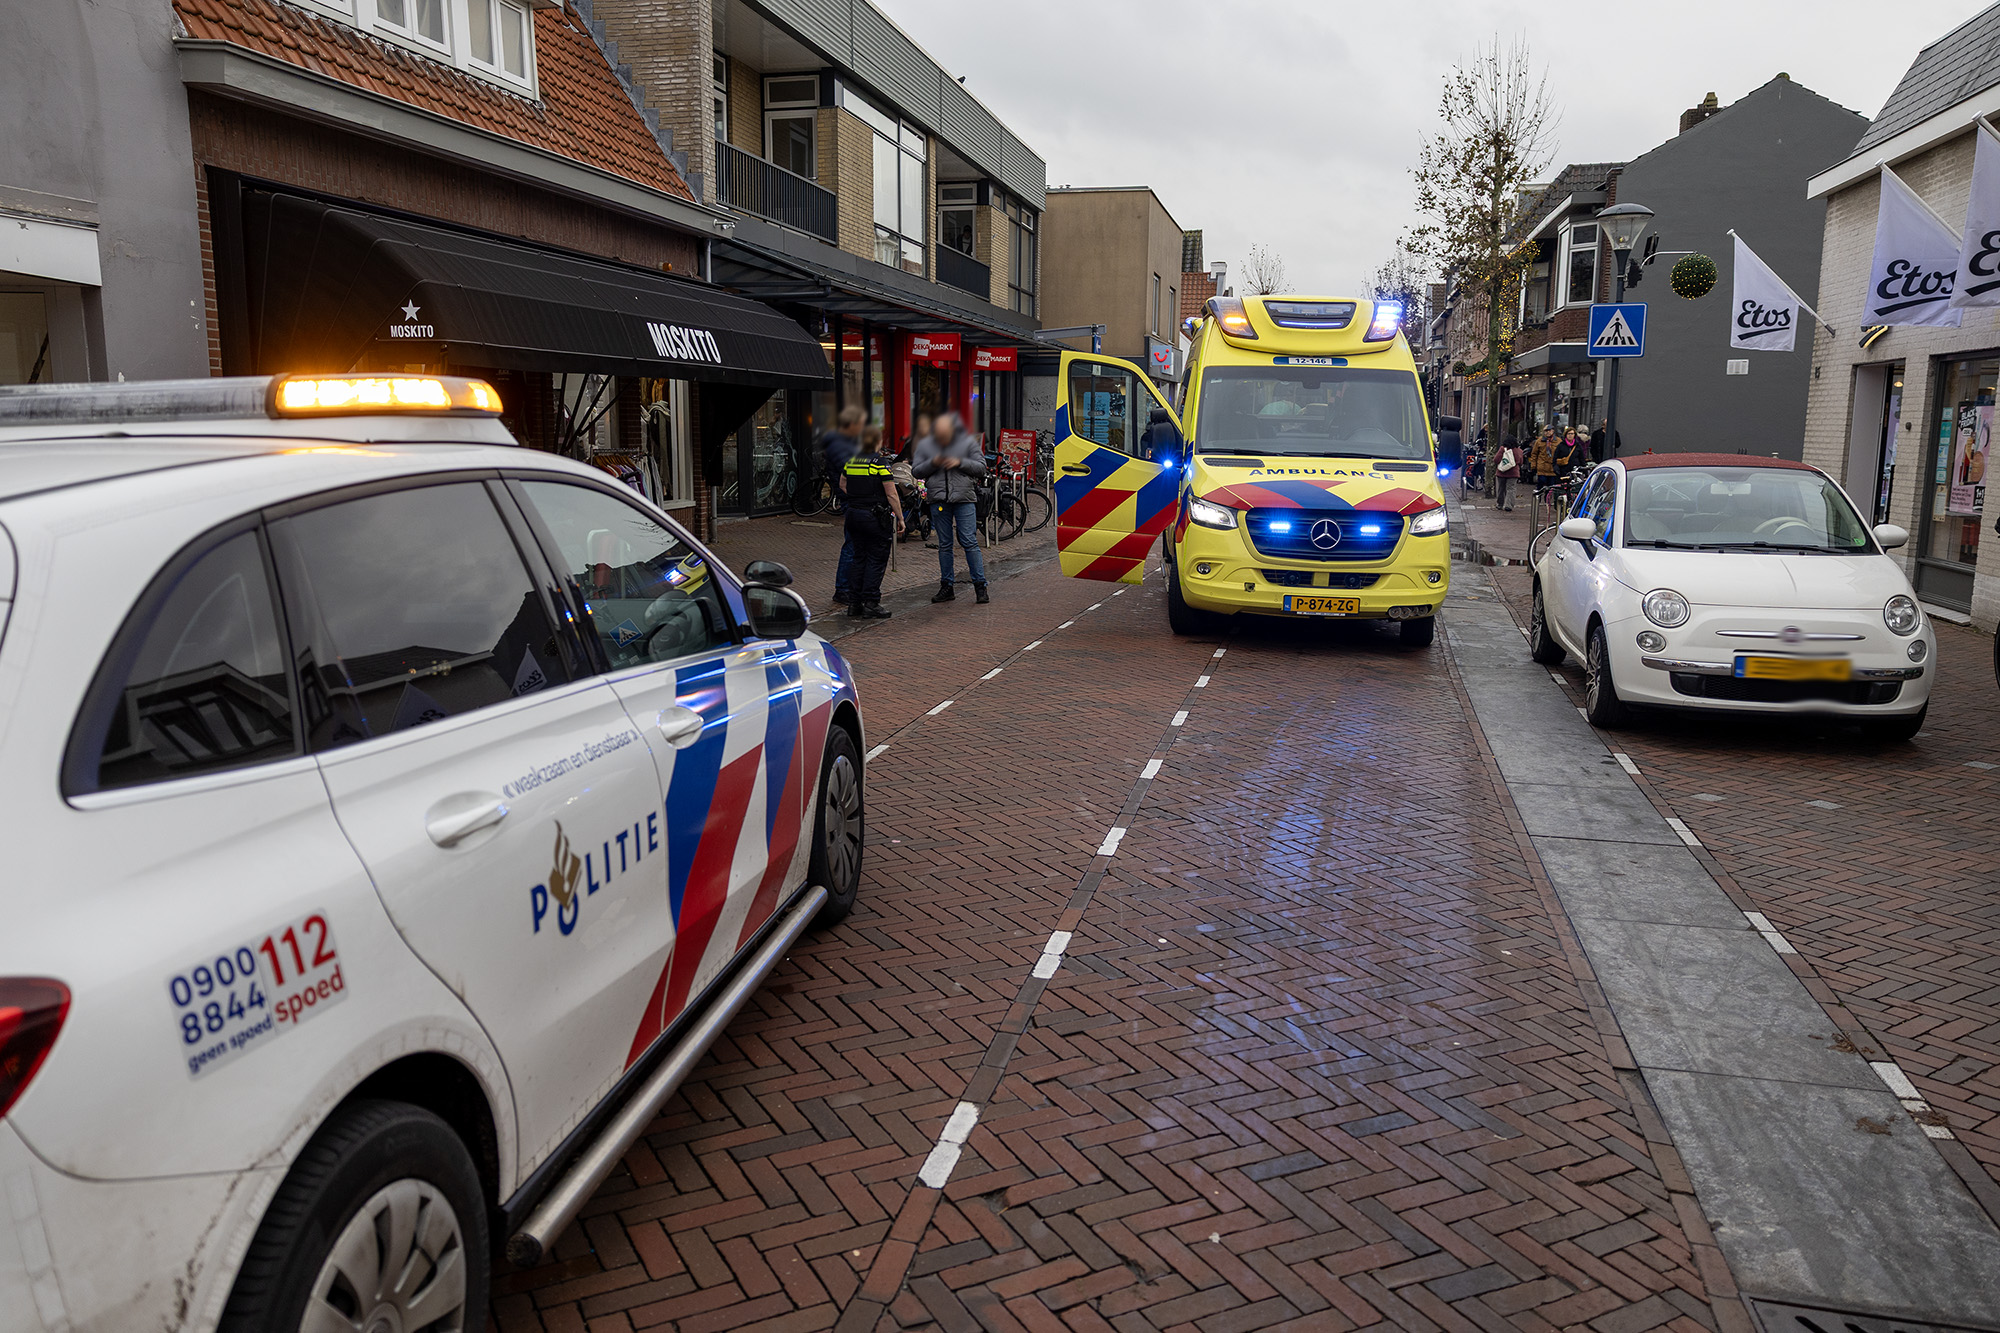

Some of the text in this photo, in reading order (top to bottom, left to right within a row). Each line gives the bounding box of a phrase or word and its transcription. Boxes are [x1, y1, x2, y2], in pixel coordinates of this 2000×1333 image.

[1876, 259, 1957, 299] Etos
[390, 324, 434, 338] MOSKITO
[1737, 299, 1791, 329] Etos
[646, 322, 722, 364] MOSKITO
[1295, 357, 1327, 365] 12-146
[1249, 468, 1395, 481] AMBULANCE
[1296, 598, 1354, 612] P-874-ZG
[511, 757, 574, 795] waakzaam
[570, 752, 588, 768] en
[583, 731, 633, 762] dienstbaar
[530, 811, 658, 936] POLITIE
[259, 915, 337, 987] 112
[169, 947, 256, 1007] 0900
[275, 963, 345, 1024] spoed
[181, 981, 266, 1046] 8844
[188, 1014, 273, 1075] geen spoed
